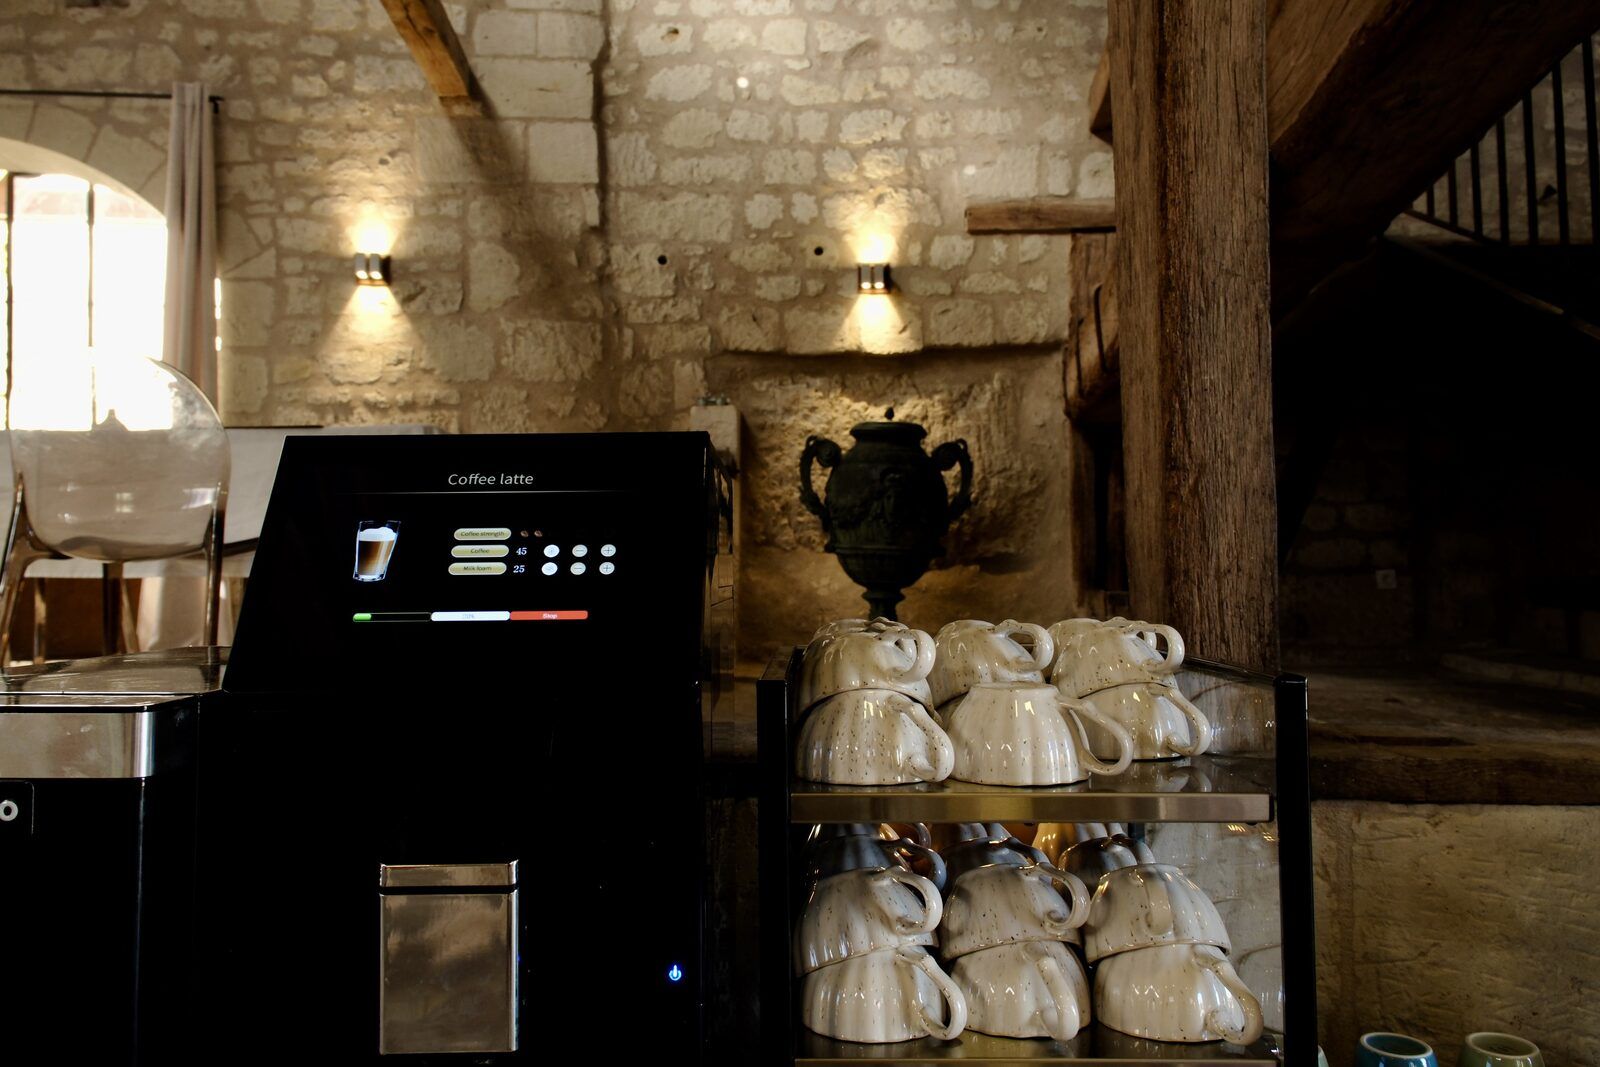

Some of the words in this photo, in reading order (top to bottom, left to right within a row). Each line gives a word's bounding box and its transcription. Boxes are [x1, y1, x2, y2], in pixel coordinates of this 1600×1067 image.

[448, 473, 496, 485] Coffee
[500, 473, 534, 485] latte
[516, 547, 528, 556] 45
[513, 564, 526, 573] 25
